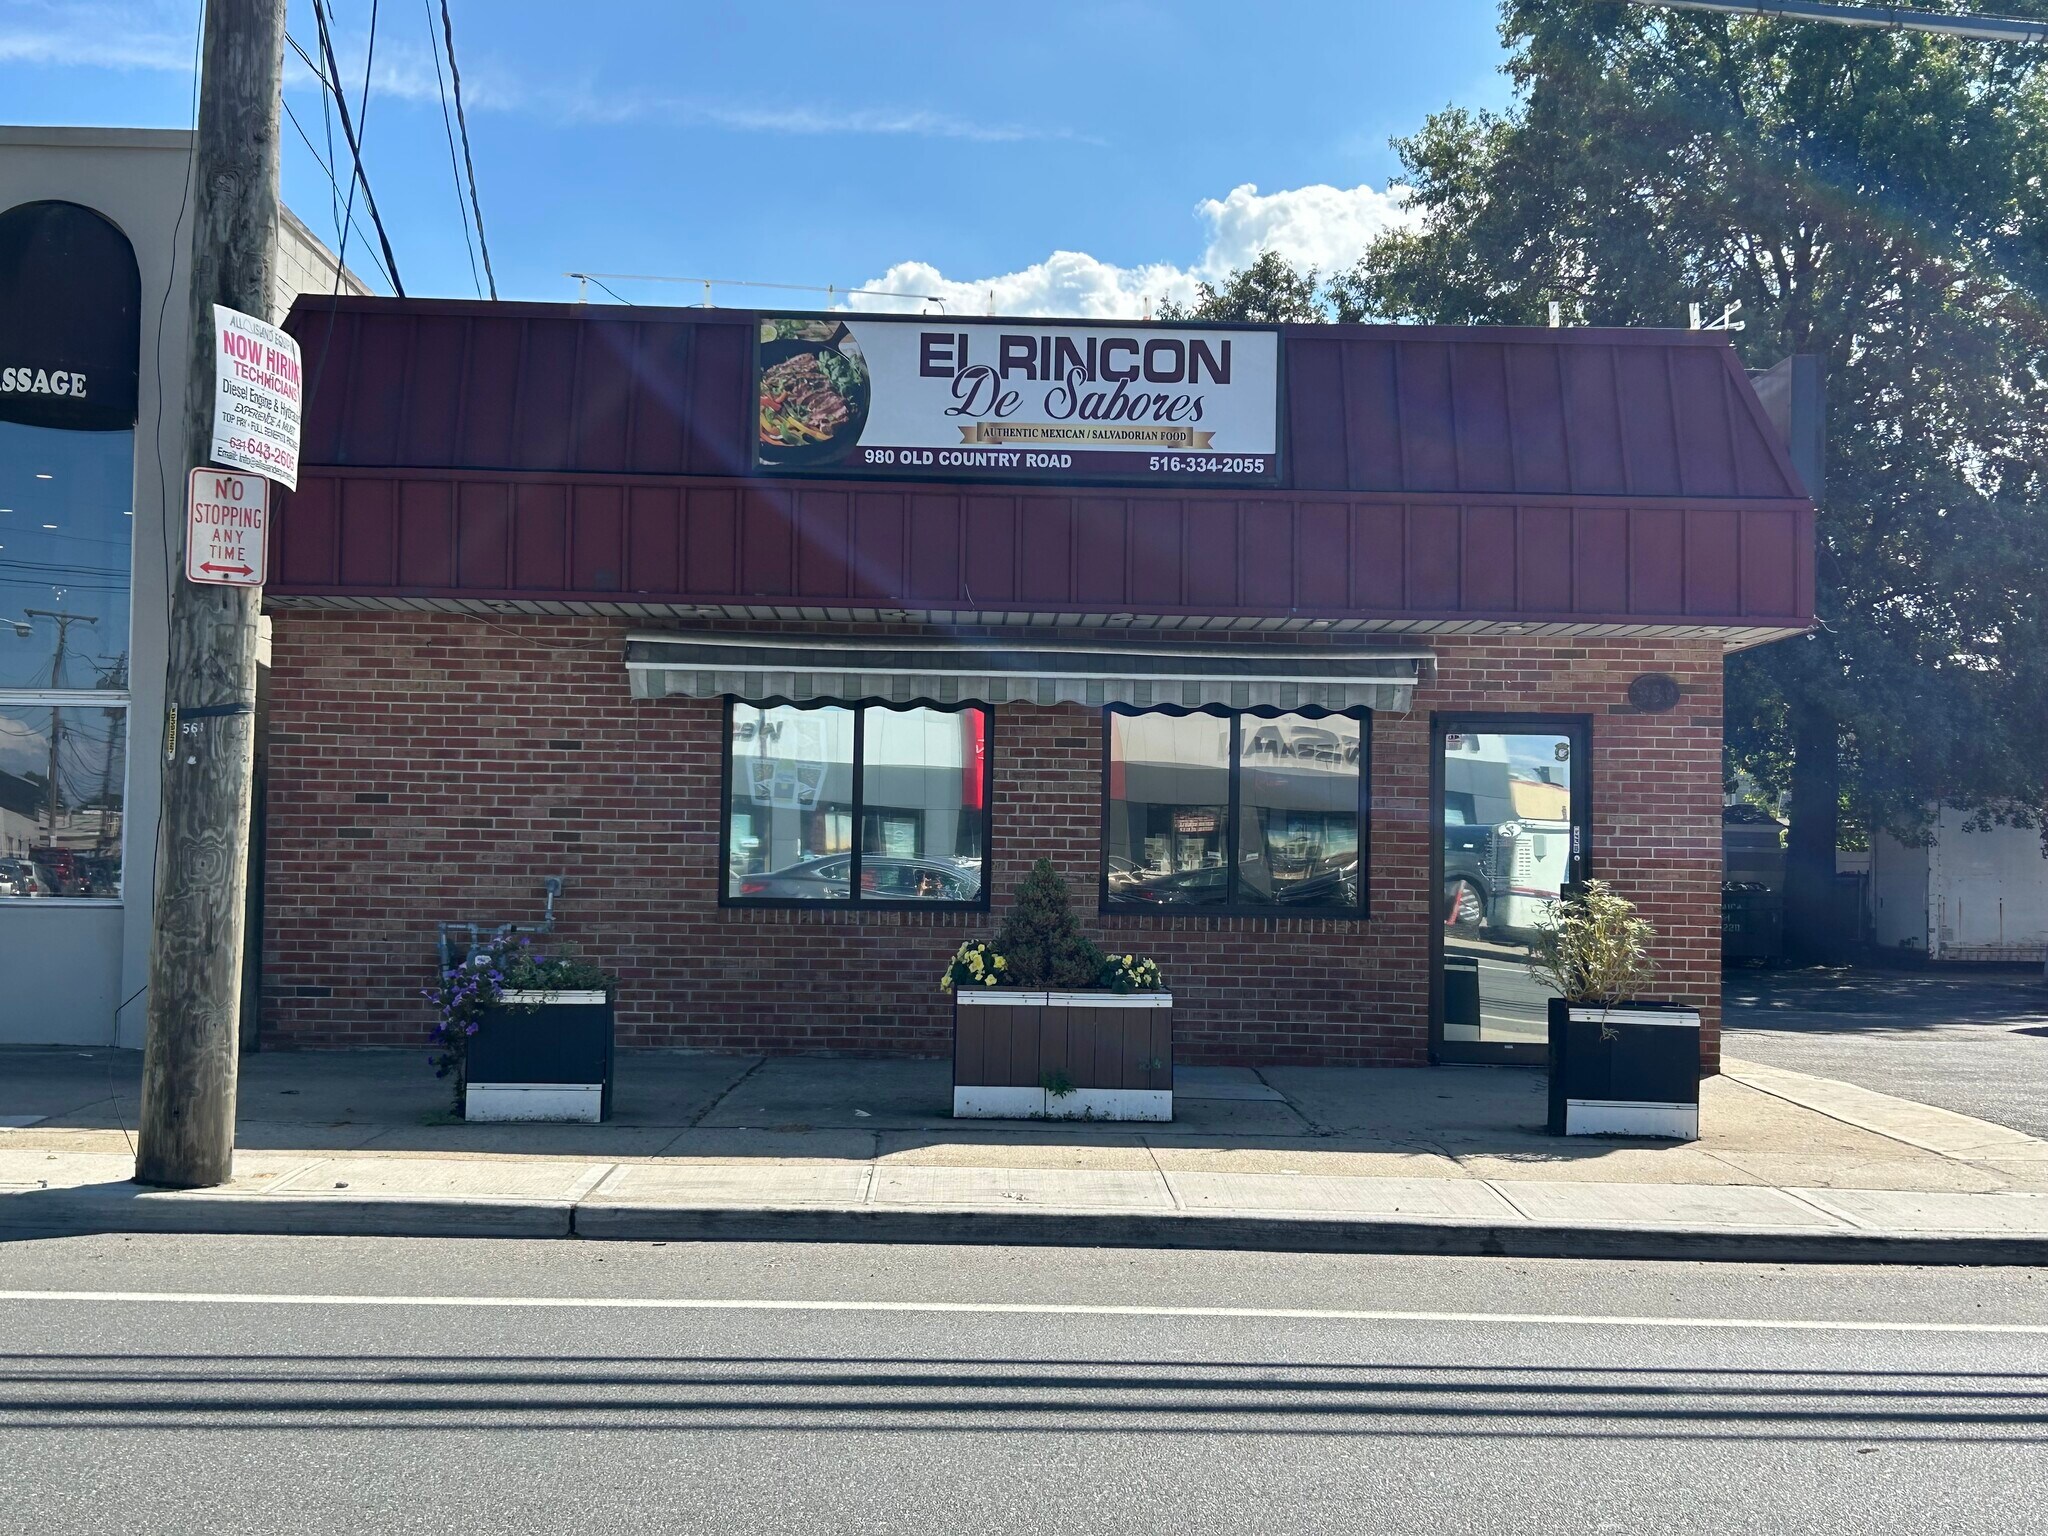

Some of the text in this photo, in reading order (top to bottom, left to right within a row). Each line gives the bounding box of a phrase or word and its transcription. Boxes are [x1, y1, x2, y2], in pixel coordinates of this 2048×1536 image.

[223, 329, 263, 366] NOW
[920, 332, 1231, 384] EL RINCON
[0, 367, 87, 398] SSAGE
[233, 360, 297, 402] TECHNICIANS
[944, 365, 1204, 422] De Sabores
[222, 378, 248, 400] Diesel
[249, 387, 272, 410] Engine
[273, 398, 279, 413] &
[222, 411, 236, 424] TOP
[984, 427, 1186, 441] AUTHENTIC MEXICAN / SALVADORIAN FOOD
[864, 449, 1072, 468] 980 OLD COUNTRY ROAD
[1150, 456, 1265, 473] 516-334-2055
[215, 478, 244, 501] NO
[195, 502, 262, 529] STOPPING
[212, 528, 244, 544] ANY
[209, 544, 246, 561] TIME
